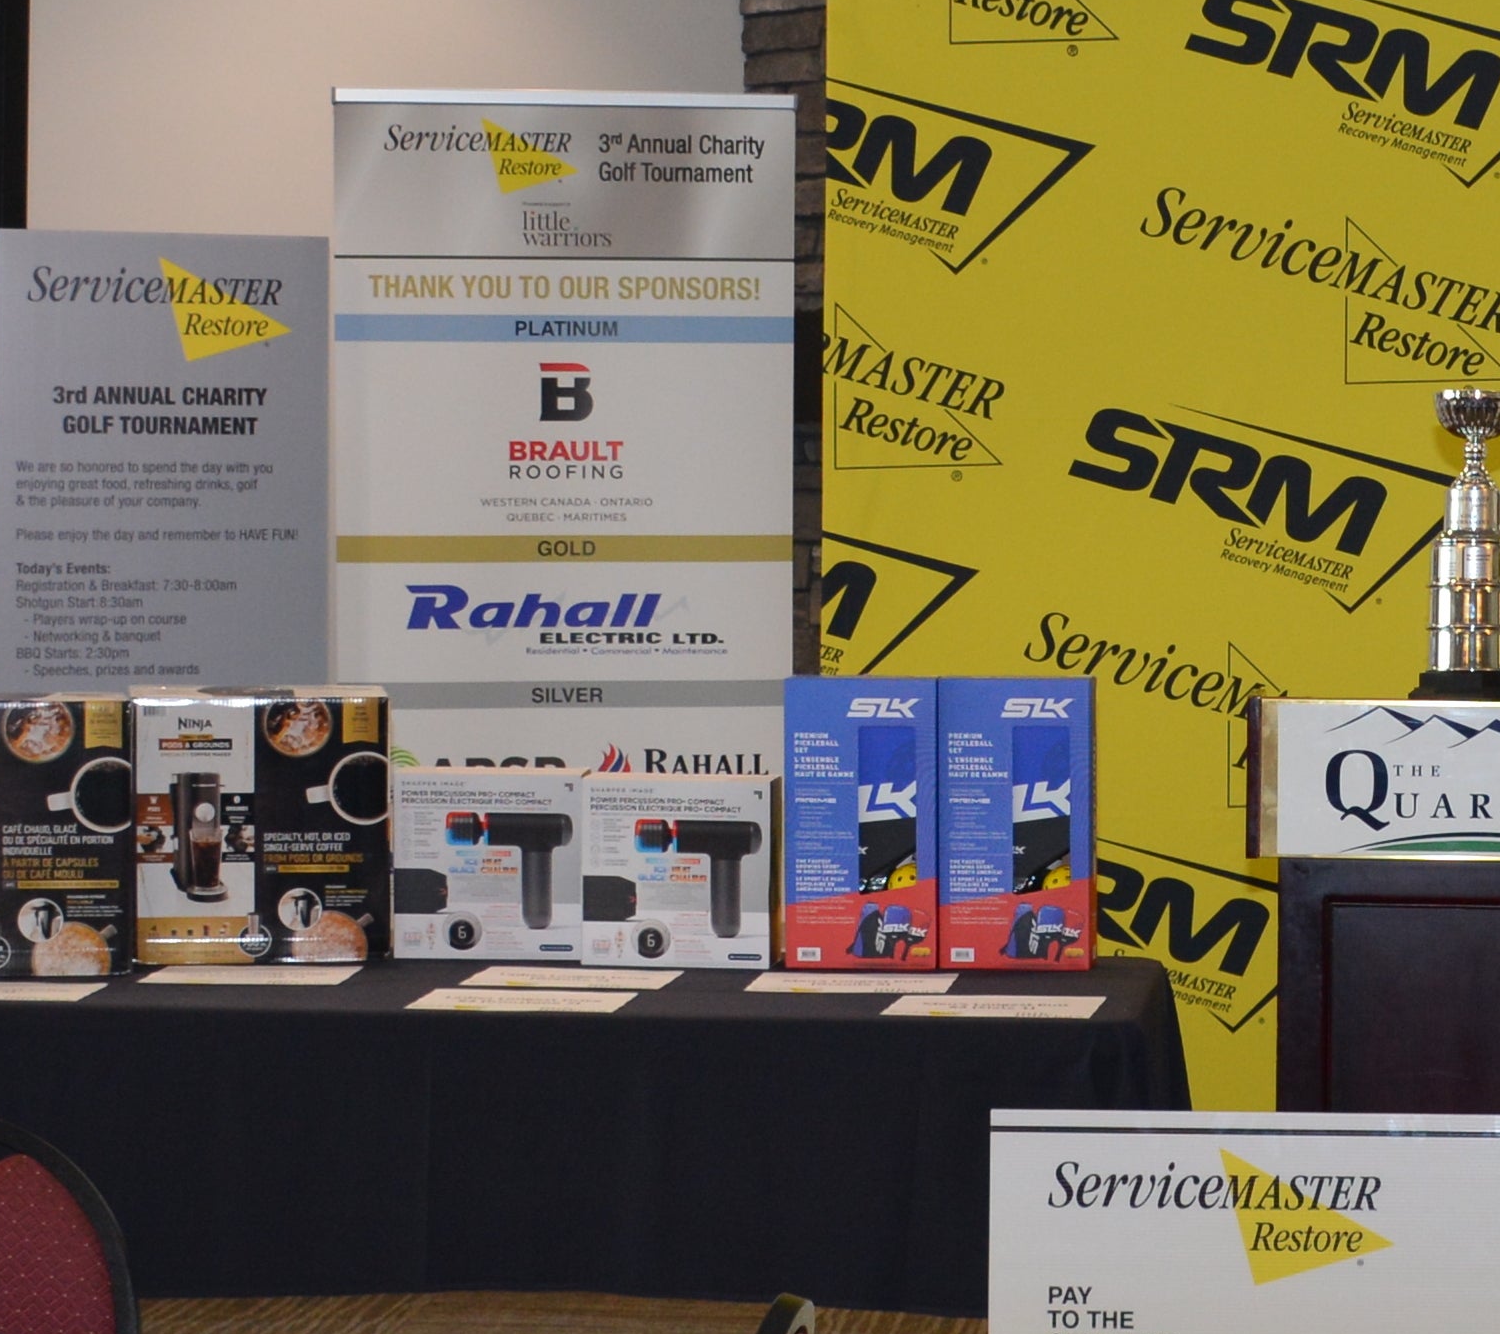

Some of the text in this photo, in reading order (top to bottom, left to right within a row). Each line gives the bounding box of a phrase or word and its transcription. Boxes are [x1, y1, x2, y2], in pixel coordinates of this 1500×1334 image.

[384, 124, 571, 153] ServiceMASTER
[599, 133, 765, 159] 3rd Annual Charity
[499, 158, 562, 176] Restore
[599, 162, 753, 183] Golf Tournament
[523, 210, 570, 232] little
[523, 231, 612, 248] warriors
[28, 266, 282, 306] ServiceMASTER
[369, 275, 760, 300] THANK YOU TO OUR SPONSORS!
[184, 313, 269, 336] Restore
[515, 320, 617, 337] PLATINUM
[53, 386, 266, 406] 3rd ANNUAL CHARITY
[63, 416, 258, 435] GOLF TOURNAMENT
[510, 441, 624, 461] BRAULT
[510, 465, 624, 479] ROOFING
[16, 529, 298, 543] Please enjoy the day and remember to HAVE FUN!
[538, 541, 595, 557] GOLD
[16, 563, 110, 576] Today's Events:
[405, 585, 662, 630] Rahall
[540, 633, 724, 644] ELECTRIC LTD.
[532, 688, 603, 704] SILVER
[847, 698, 922, 718] SLK
[1001, 698, 1075, 718] SLK
[178, 717, 212, 732] NINJA
[644, 749, 768, 775] RAHALL
[1393, 764, 1441, 777] THE
[1048, 1160, 1382, 1212] ServiceMASTER
[1249, 1222, 1362, 1253] Restore
[1048, 1287, 1092, 1305] PAY
[1048, 1310, 1134, 1329] TO THE
